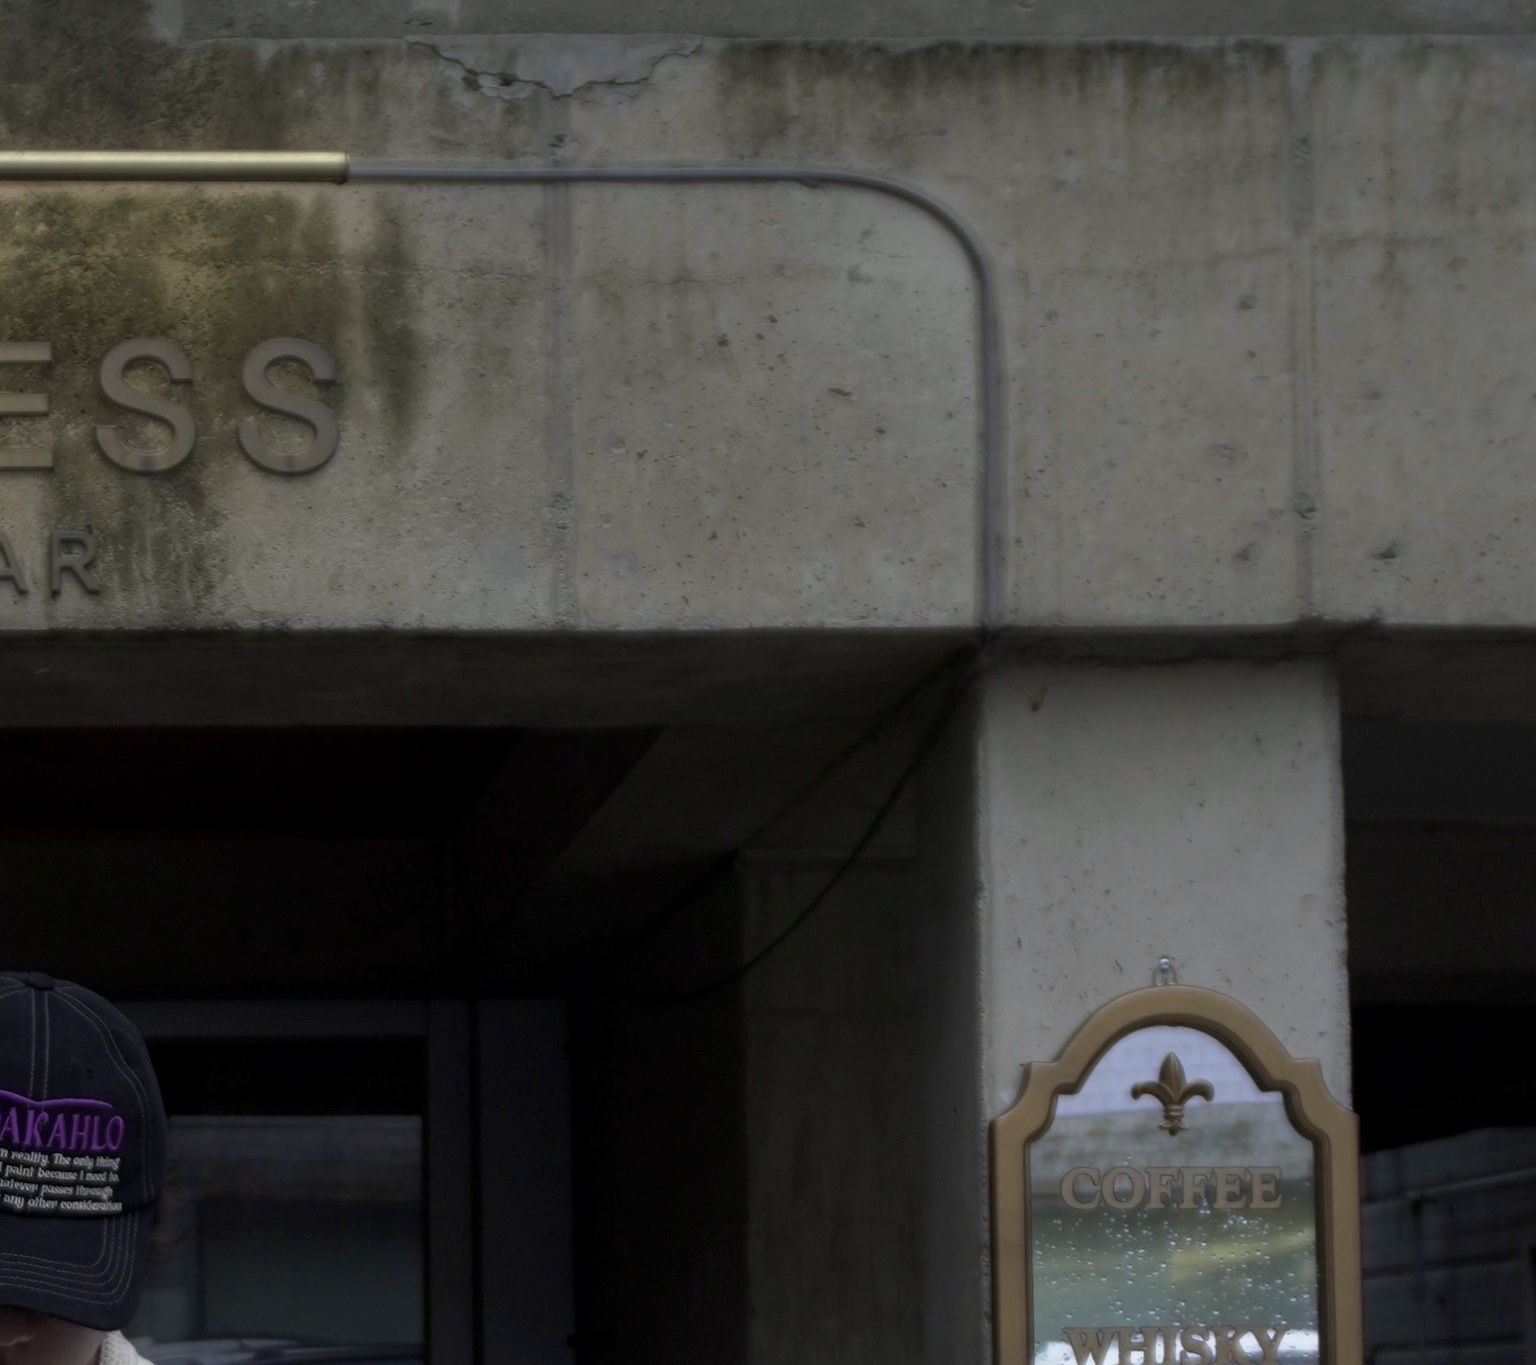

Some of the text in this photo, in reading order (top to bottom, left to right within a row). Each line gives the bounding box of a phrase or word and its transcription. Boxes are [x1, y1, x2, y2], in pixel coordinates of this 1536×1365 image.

[10, 1150, 50, 1167] reality.
[52, 1152, 72, 1165] The
[73, 1155, 94, 1169] only
[95, 1156, 121, 1170] thing
[5, 1164, 35, 1177] paint
[37, 1166, 78, 1181] because
[39, 1183, 74, 1198] passes
[75, 1185, 113, 1200] through
[1061, 1167, 1283, 1210] COFFEE
[3, 1193, 24, 1209] any
[27, 1196, 58, 1209] other
